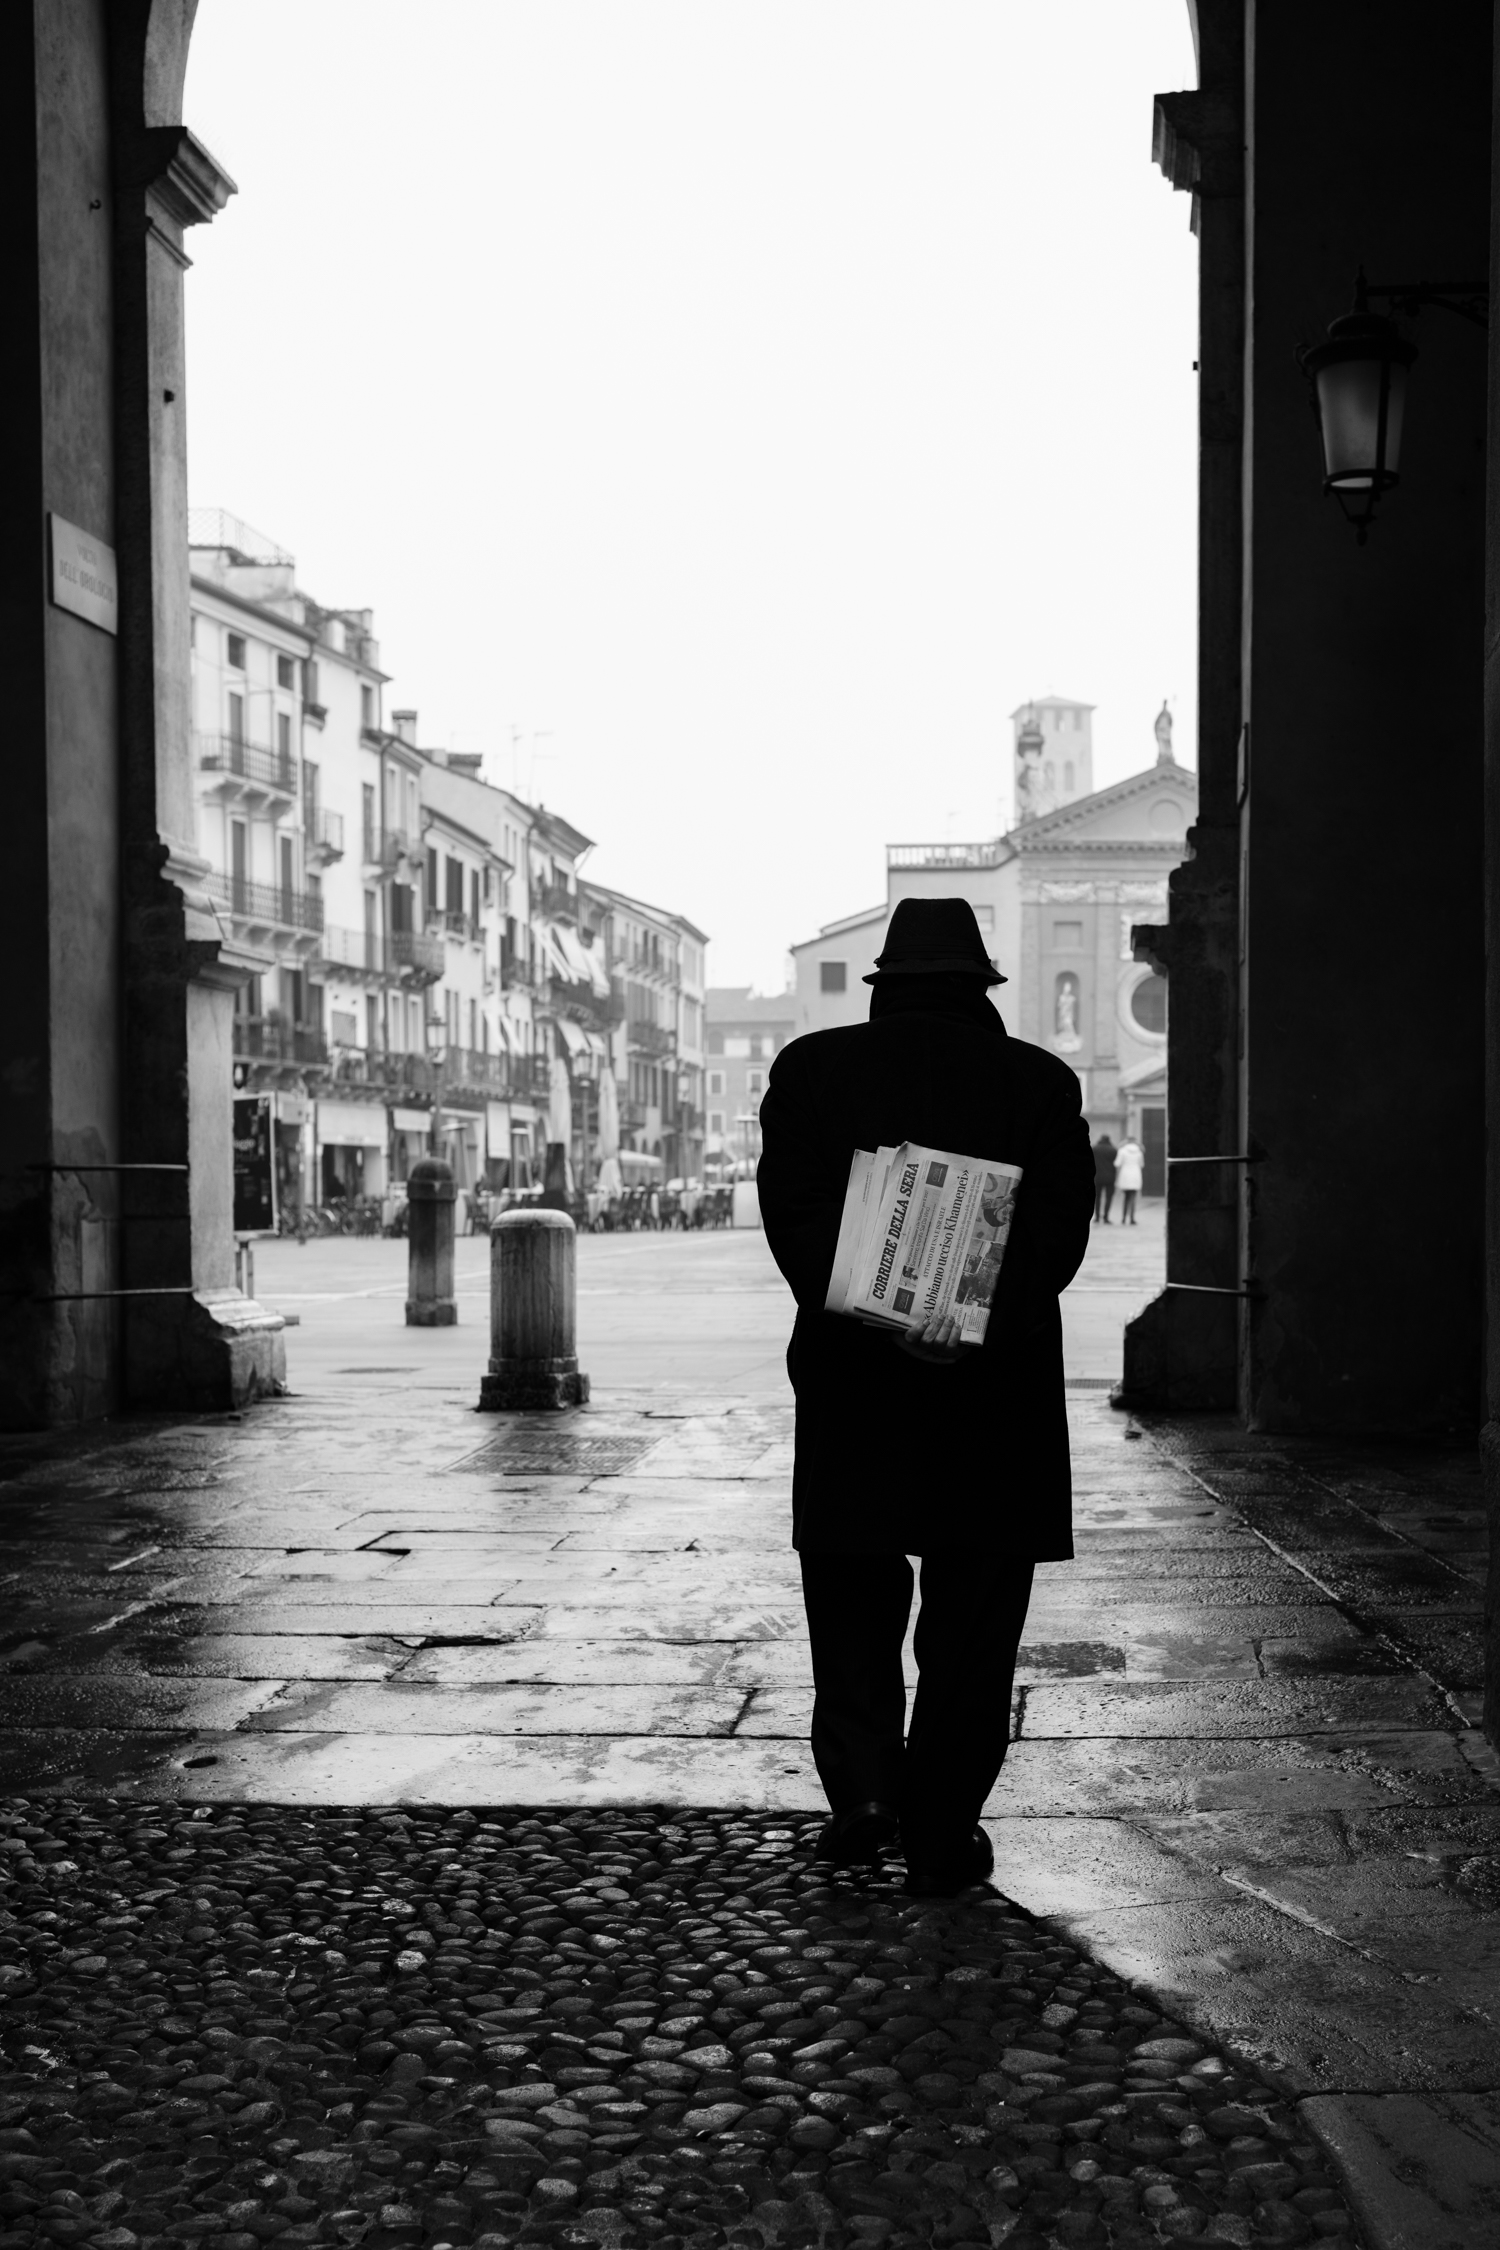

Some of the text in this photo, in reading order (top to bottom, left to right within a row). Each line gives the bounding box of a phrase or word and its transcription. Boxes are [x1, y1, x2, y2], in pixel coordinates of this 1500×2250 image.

[897, 1160, 919, 1198] SERA
[934, 1205, 947, 1230] ISRAELE
[942, 1166, 971, 1232] Khamenei»
[886, 1196, 909, 1240] DELLA
[928, 1244, 936, 1253] DI
[930, 1233, 939, 1246] USA
[933, 1230, 954, 1266] ucciso
[871, 1237, 899, 1301] CORRIERE
[922, 1252, 934, 1279] ATTACCO
[919, 1263, 946, 1321] «Abbiamo
